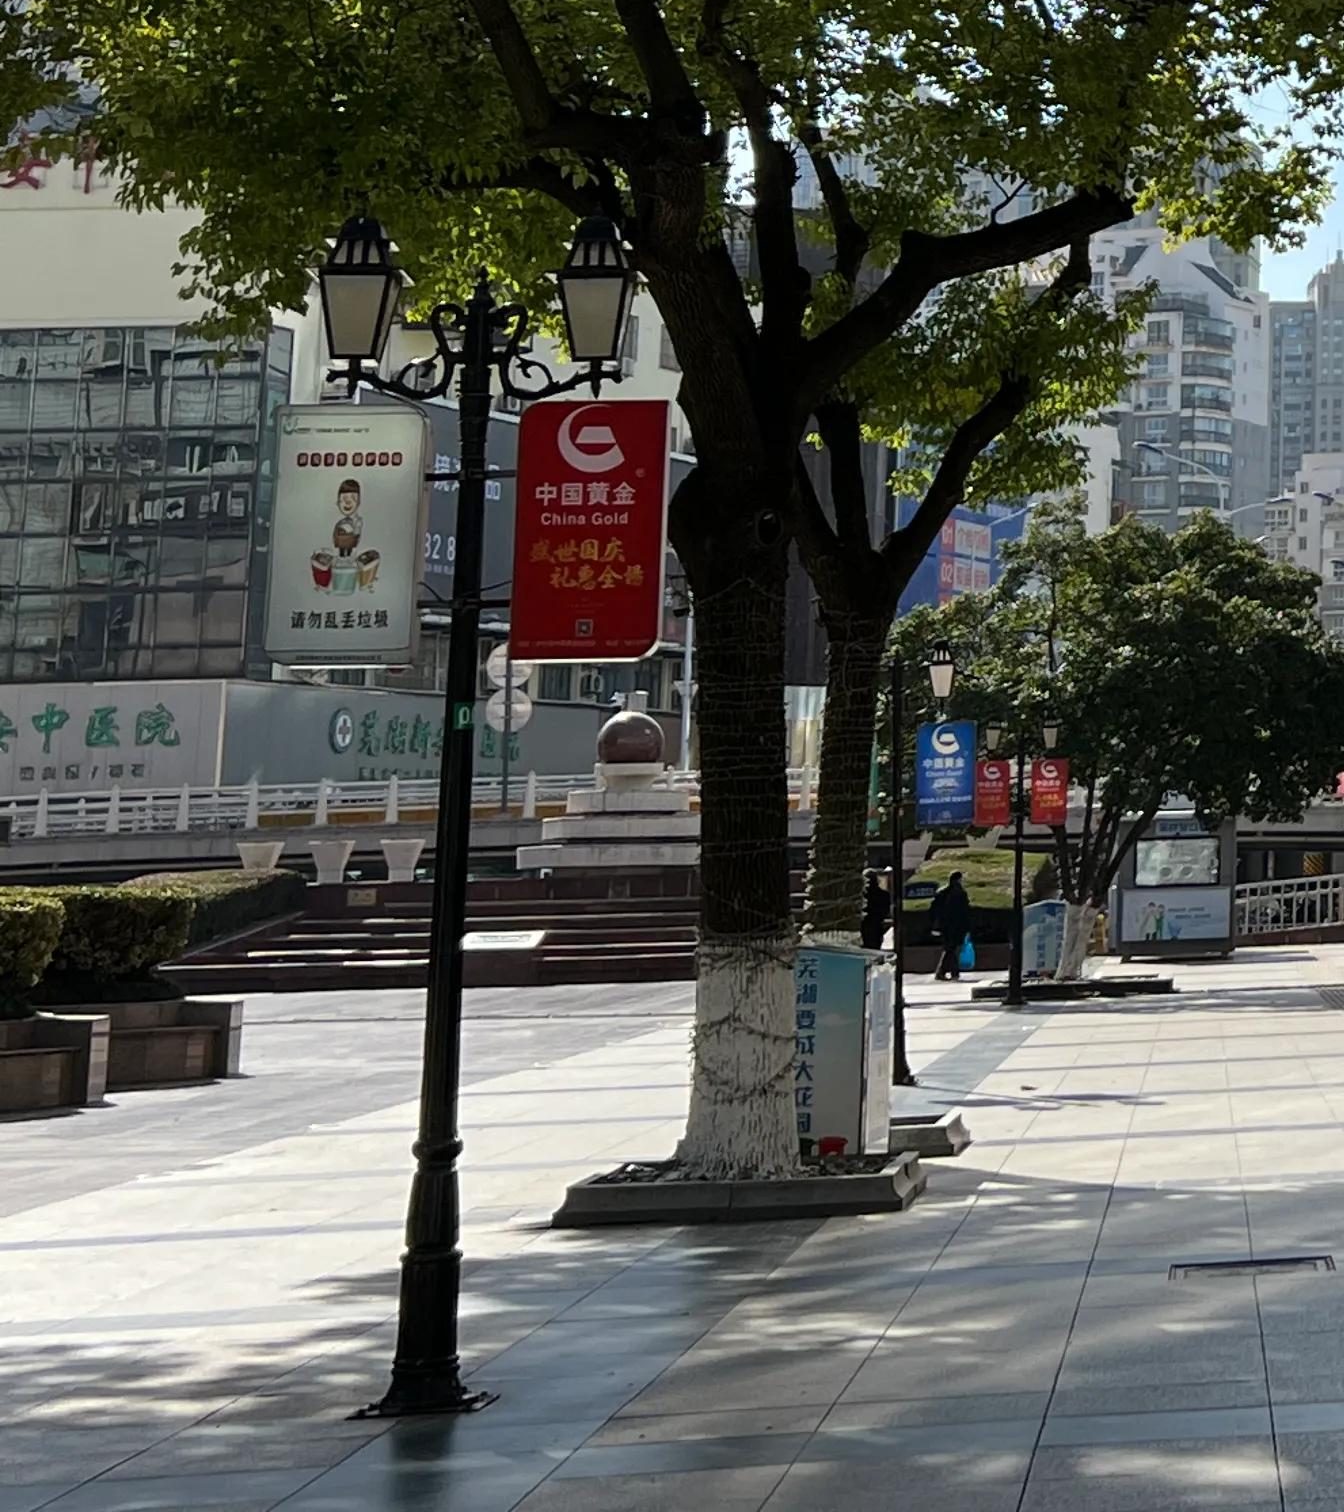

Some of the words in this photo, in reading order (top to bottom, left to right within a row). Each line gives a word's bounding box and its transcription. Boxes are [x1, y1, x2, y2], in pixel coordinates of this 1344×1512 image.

[535, 481, 636, 507] 中国黄金
[540, 512, 586, 526] China
[591, 512, 629, 526] Gold
[290, 610, 389, 630] 请勿乱丢垃圾
